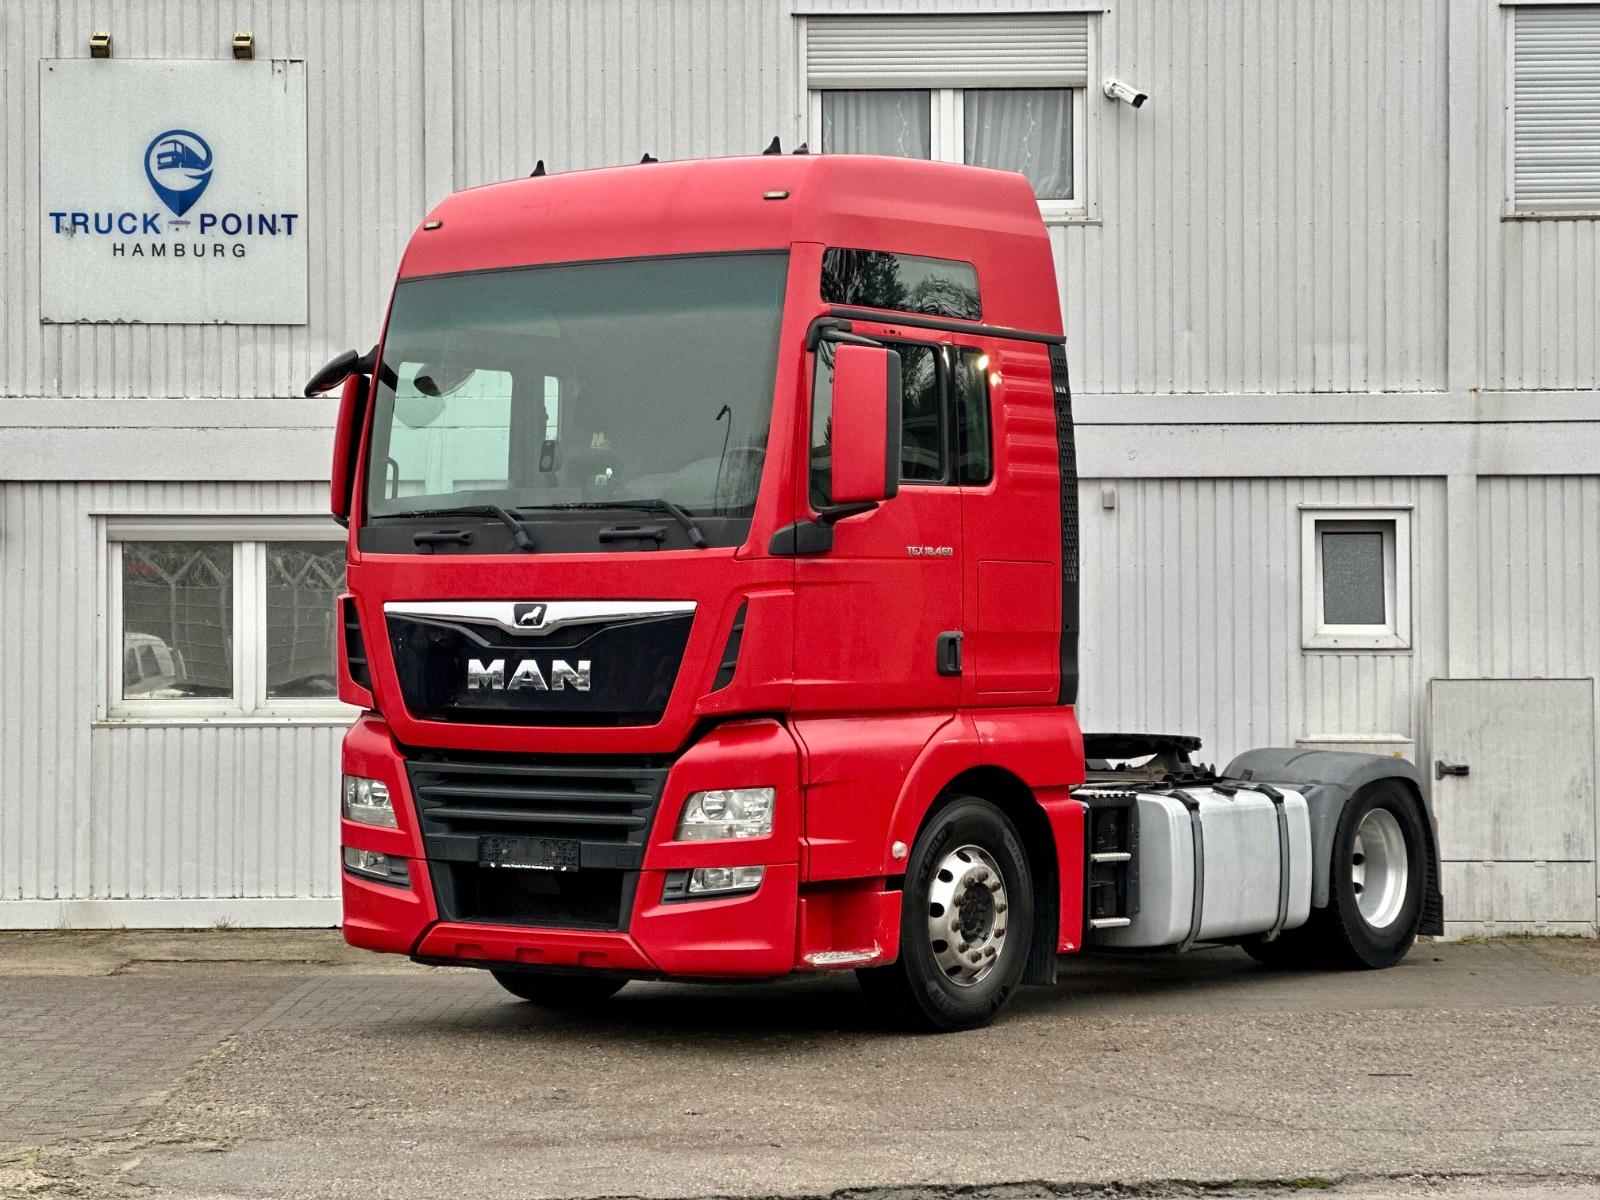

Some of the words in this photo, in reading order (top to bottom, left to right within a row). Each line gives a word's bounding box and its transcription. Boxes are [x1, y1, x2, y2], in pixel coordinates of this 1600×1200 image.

[49, 212, 162, 235] TRUCK
[199, 213, 298, 235] POINT
[112, 242, 246, 258] HAMBURG
[467, 659, 591, 691] MAN
